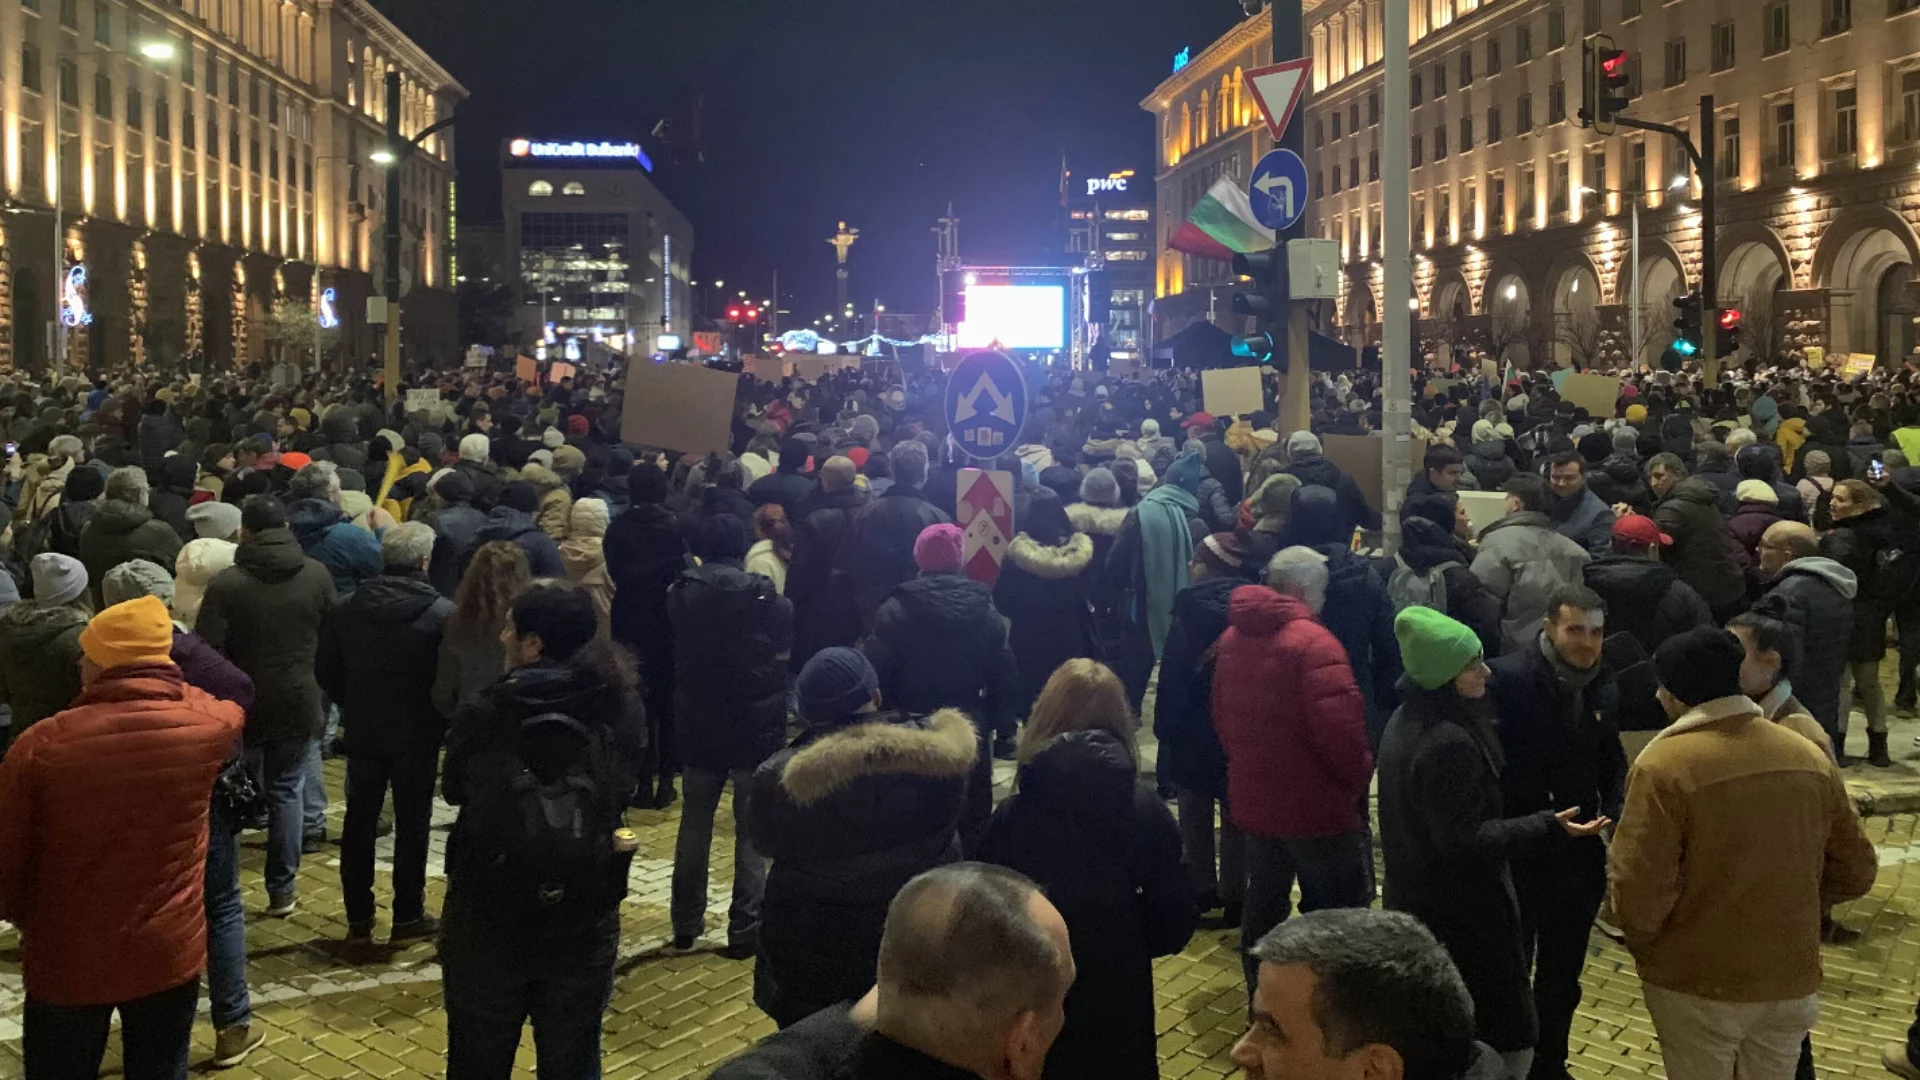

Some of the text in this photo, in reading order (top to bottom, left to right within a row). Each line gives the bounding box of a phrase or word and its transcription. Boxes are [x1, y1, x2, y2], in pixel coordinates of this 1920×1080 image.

[530, 141, 635, 157] UniCredit Bulbank
[1086, 178, 1127, 195] pwc
